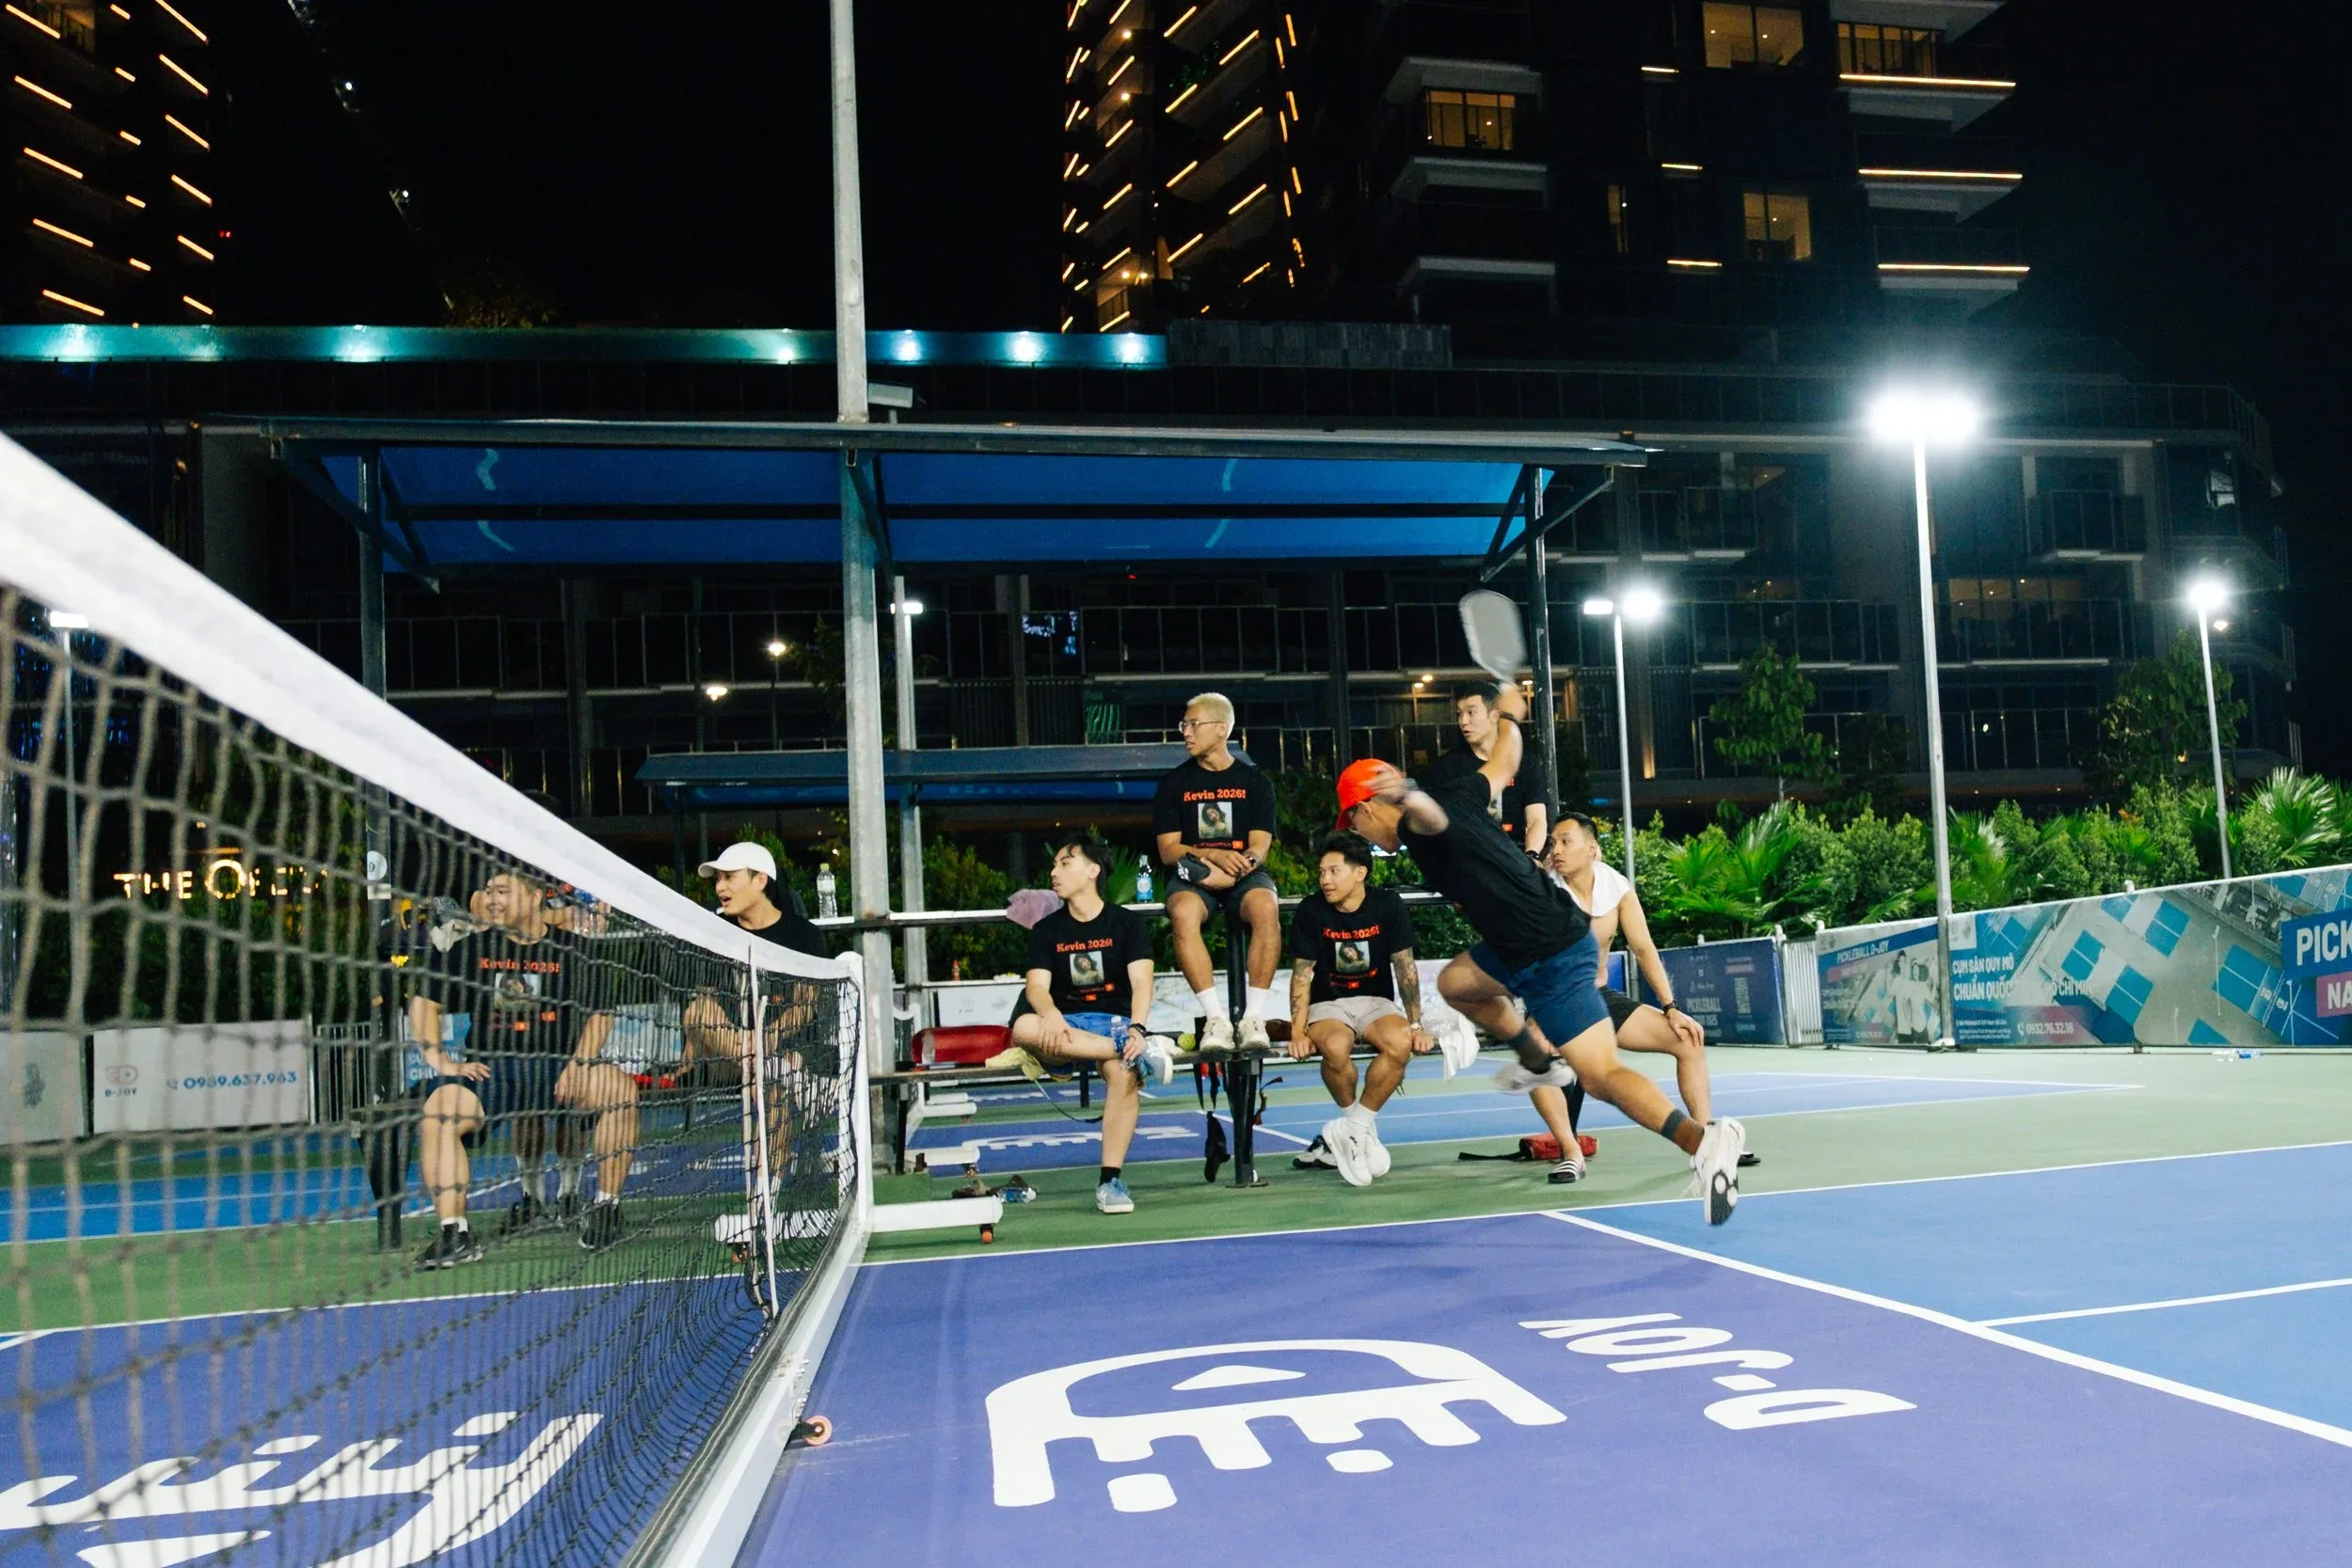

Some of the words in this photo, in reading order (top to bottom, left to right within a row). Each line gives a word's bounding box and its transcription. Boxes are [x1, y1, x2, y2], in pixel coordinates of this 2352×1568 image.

[1184, 790, 1216, 801] Kevin
[1216, 788, 1247, 799] 2026!
[113, 871, 192, 899] THE
[1323, 927, 1352, 939] Kevin
[1353, 925, 1380, 939] 2026!
[1056, 941, 1086, 953] Kevin
[2296, 920, 2352, 967] PICK
[480, 958, 519, 971] Kevin
[1969, 955, 1984, 974] SÂN
[1985, 957, 2001, 974] QUY
[2002, 952, 2014, 971] MÔ
[1518, 1313, 1917, 1431] D-JOY
